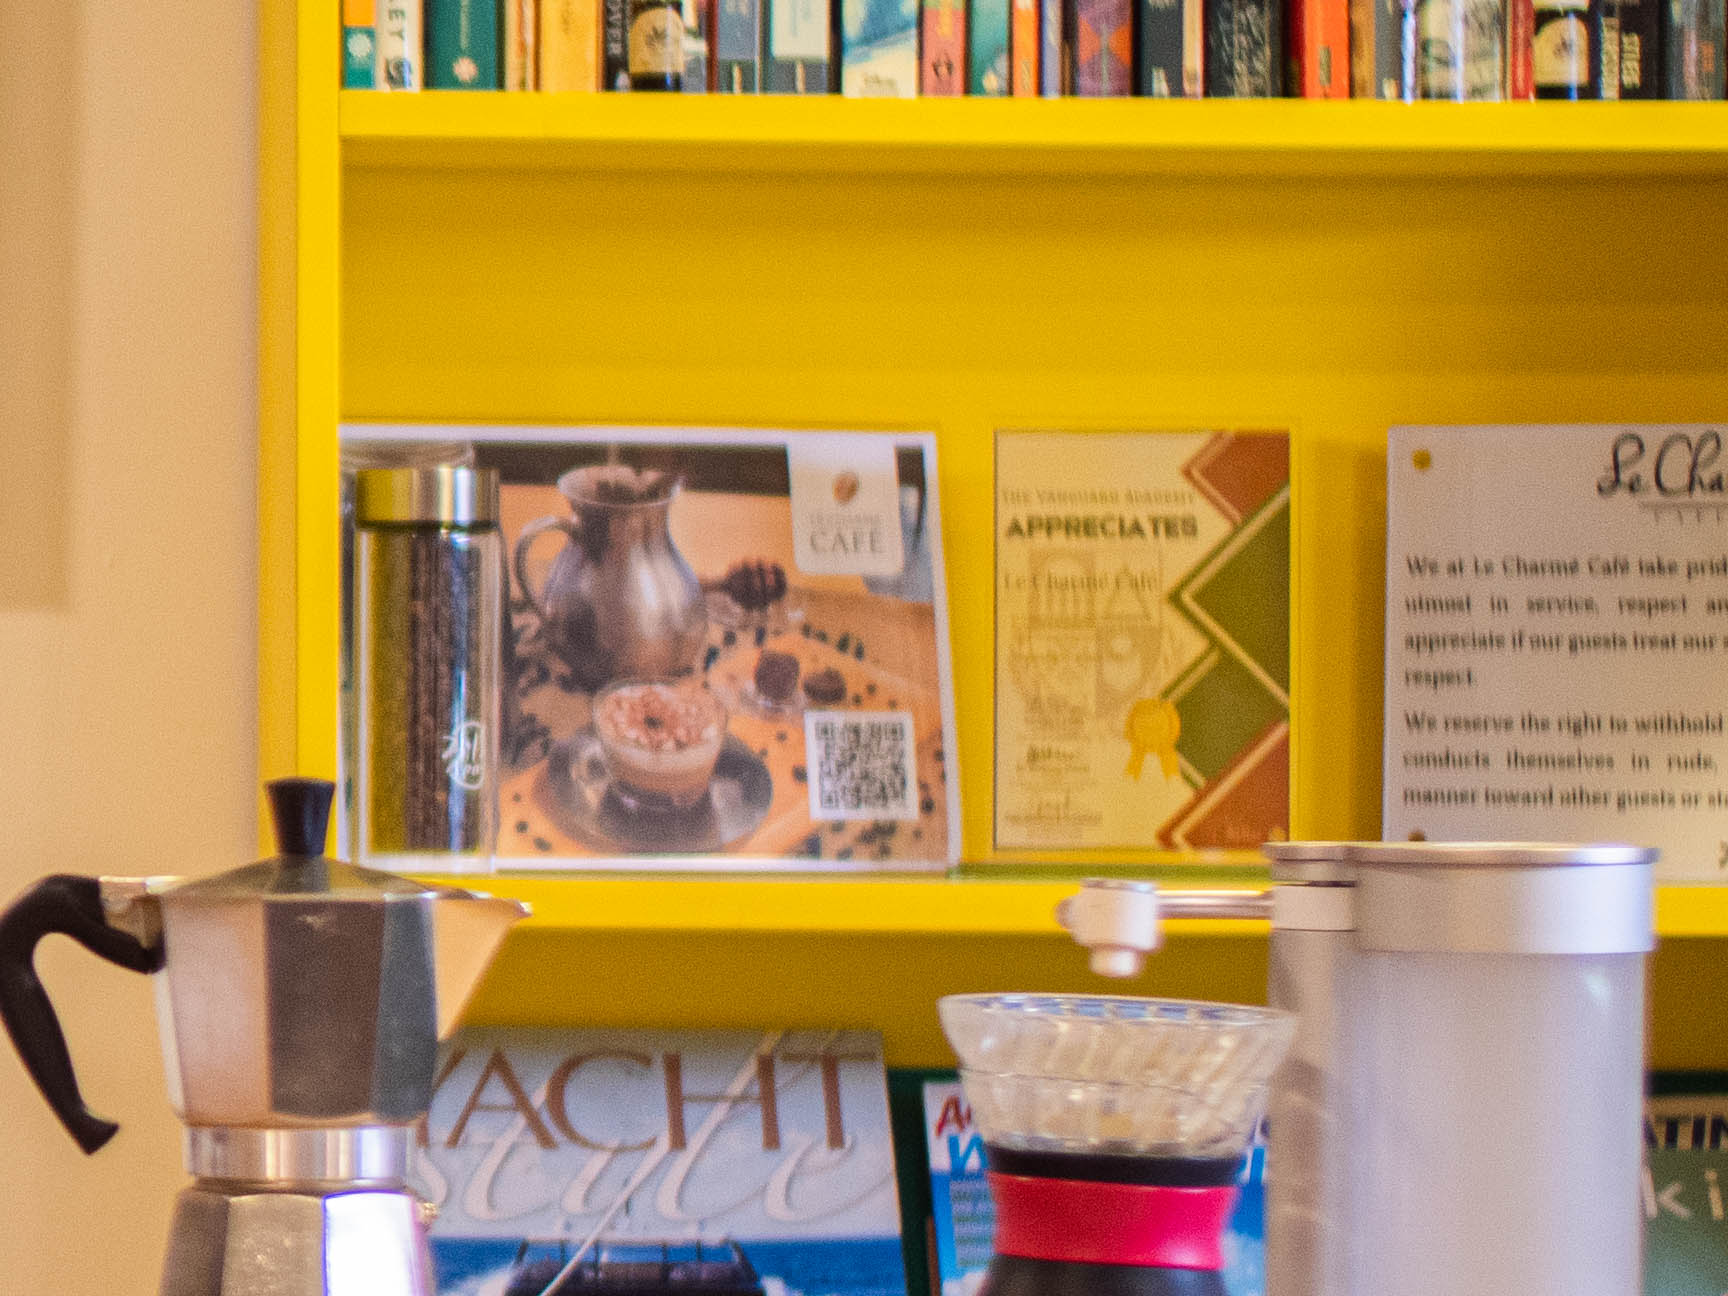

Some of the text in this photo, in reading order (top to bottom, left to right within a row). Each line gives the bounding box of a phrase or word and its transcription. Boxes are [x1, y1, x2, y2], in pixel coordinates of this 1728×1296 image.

[1596, 432, 1649, 497] Le
[1005, 515, 1199, 540] APPRECIATES
[1405, 556, 1439, 577] We
[1446, 556, 1465, 577] at
[1473, 556, 1495, 577] Le
[1638, 555, 1679, 577] take
[1404, 595, 1473, 614] utmost
[1490, 595, 1510, 614] in
[1618, 595, 1688, 619] respect
[1404, 628, 1716, 653] appreciate if our guests treat our
[1404, 711, 1725, 736] We reserve the right to withhold
[1402, 749, 1490, 770] conducts
[1506, 749, 1615, 771] themselves
[1630, 751, 1651, 771] in
[1402, 786, 1700, 812] manner toward other guests or
